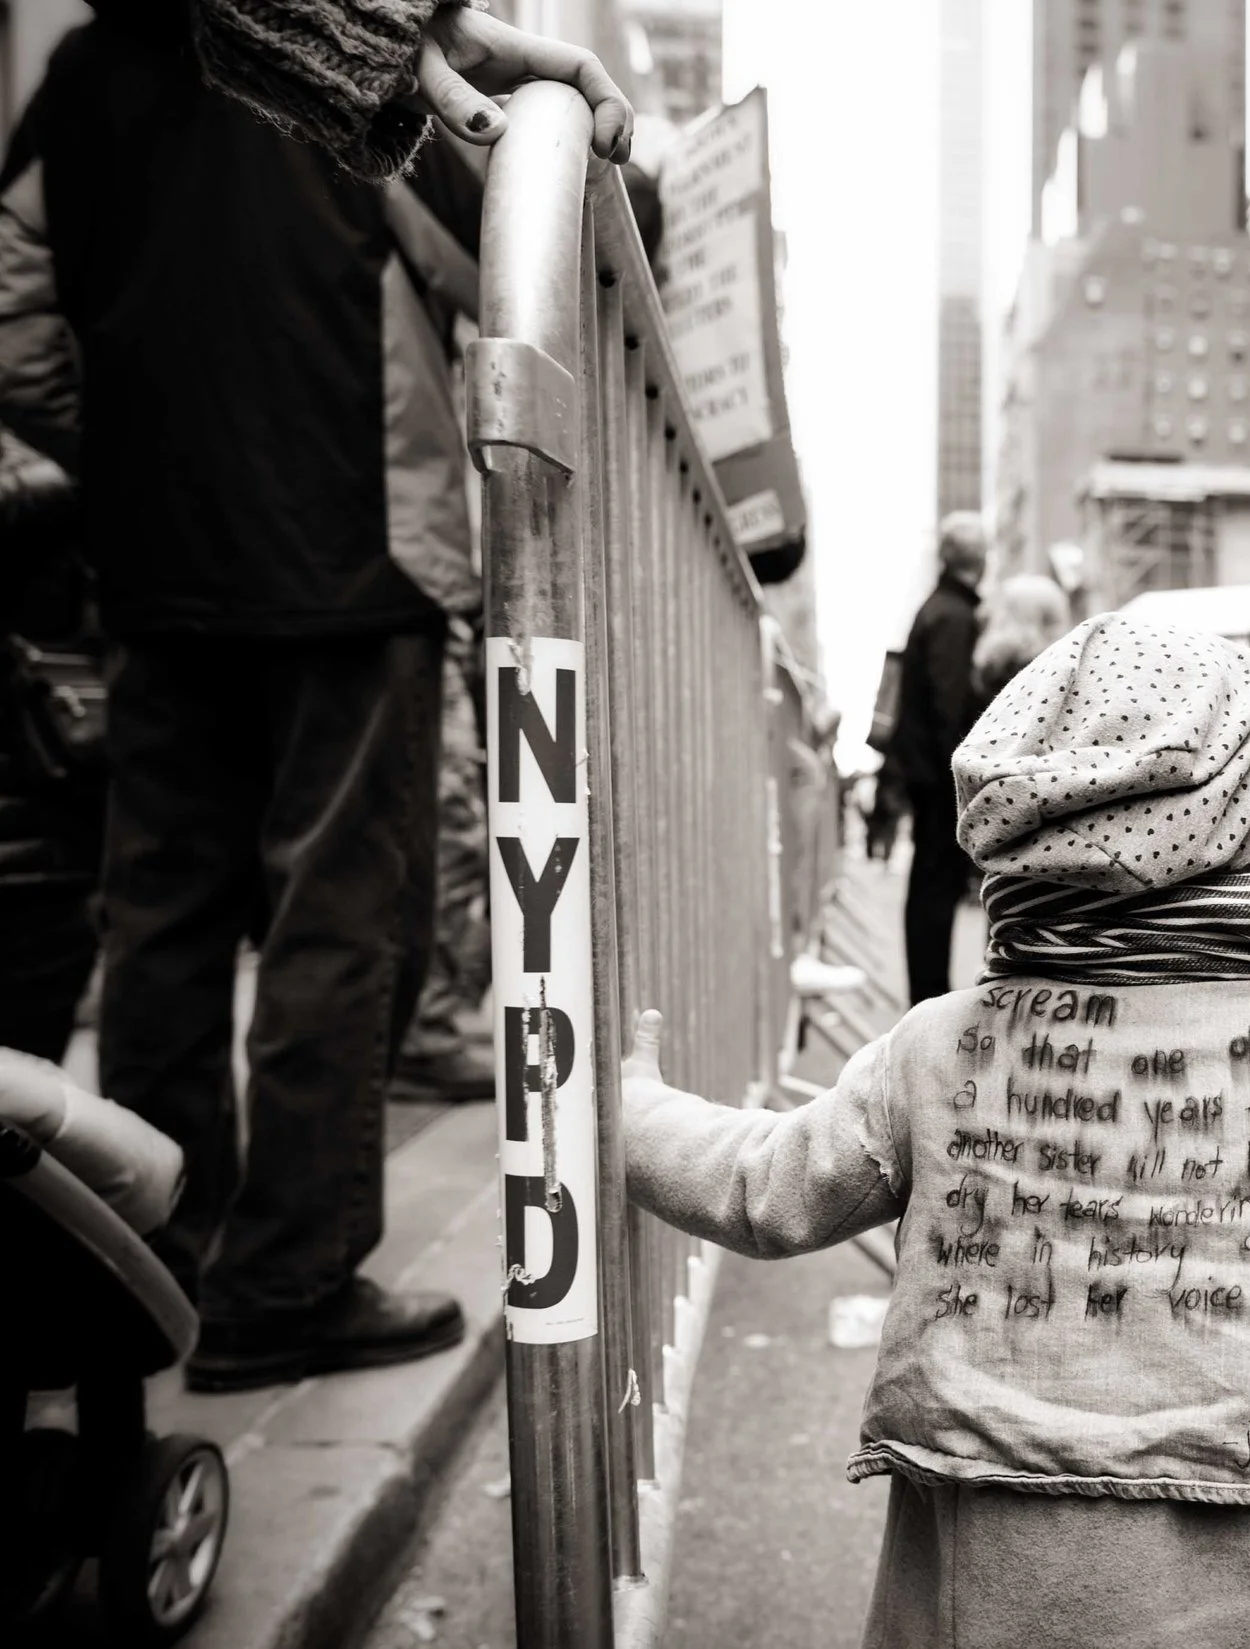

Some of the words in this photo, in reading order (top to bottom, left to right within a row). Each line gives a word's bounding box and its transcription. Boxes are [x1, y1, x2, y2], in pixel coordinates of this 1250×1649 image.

[496, 666, 580, 1310] NYPD
[980, 985, 1118, 1027] scream
[1022, 1032, 1096, 1074] that
[1131, 1049, 1184, 1076] one
[953, 1080, 977, 1110] a
[1007, 1074, 1121, 1124] hundred
[1144, 1092, 1224, 1142] years
[946, 1128, 1024, 1163] another
[1039, 1139, 1098, 1176] sister
[1181, 1146, 1224, 1181] not
[946, 1174, 988, 1237] dry
[1011, 1181, 1050, 1216] her
[1059, 1187, 1123, 1223] tears
[932, 1231, 1000, 1268] where
[1032, 1227, 1052, 1266] in
[1088, 1236, 1186, 1295] history
[1003, 1282, 1056, 1320] lost
[1084, 1281, 1128, 1320] her
[1168, 1275, 1244, 1313] voice
